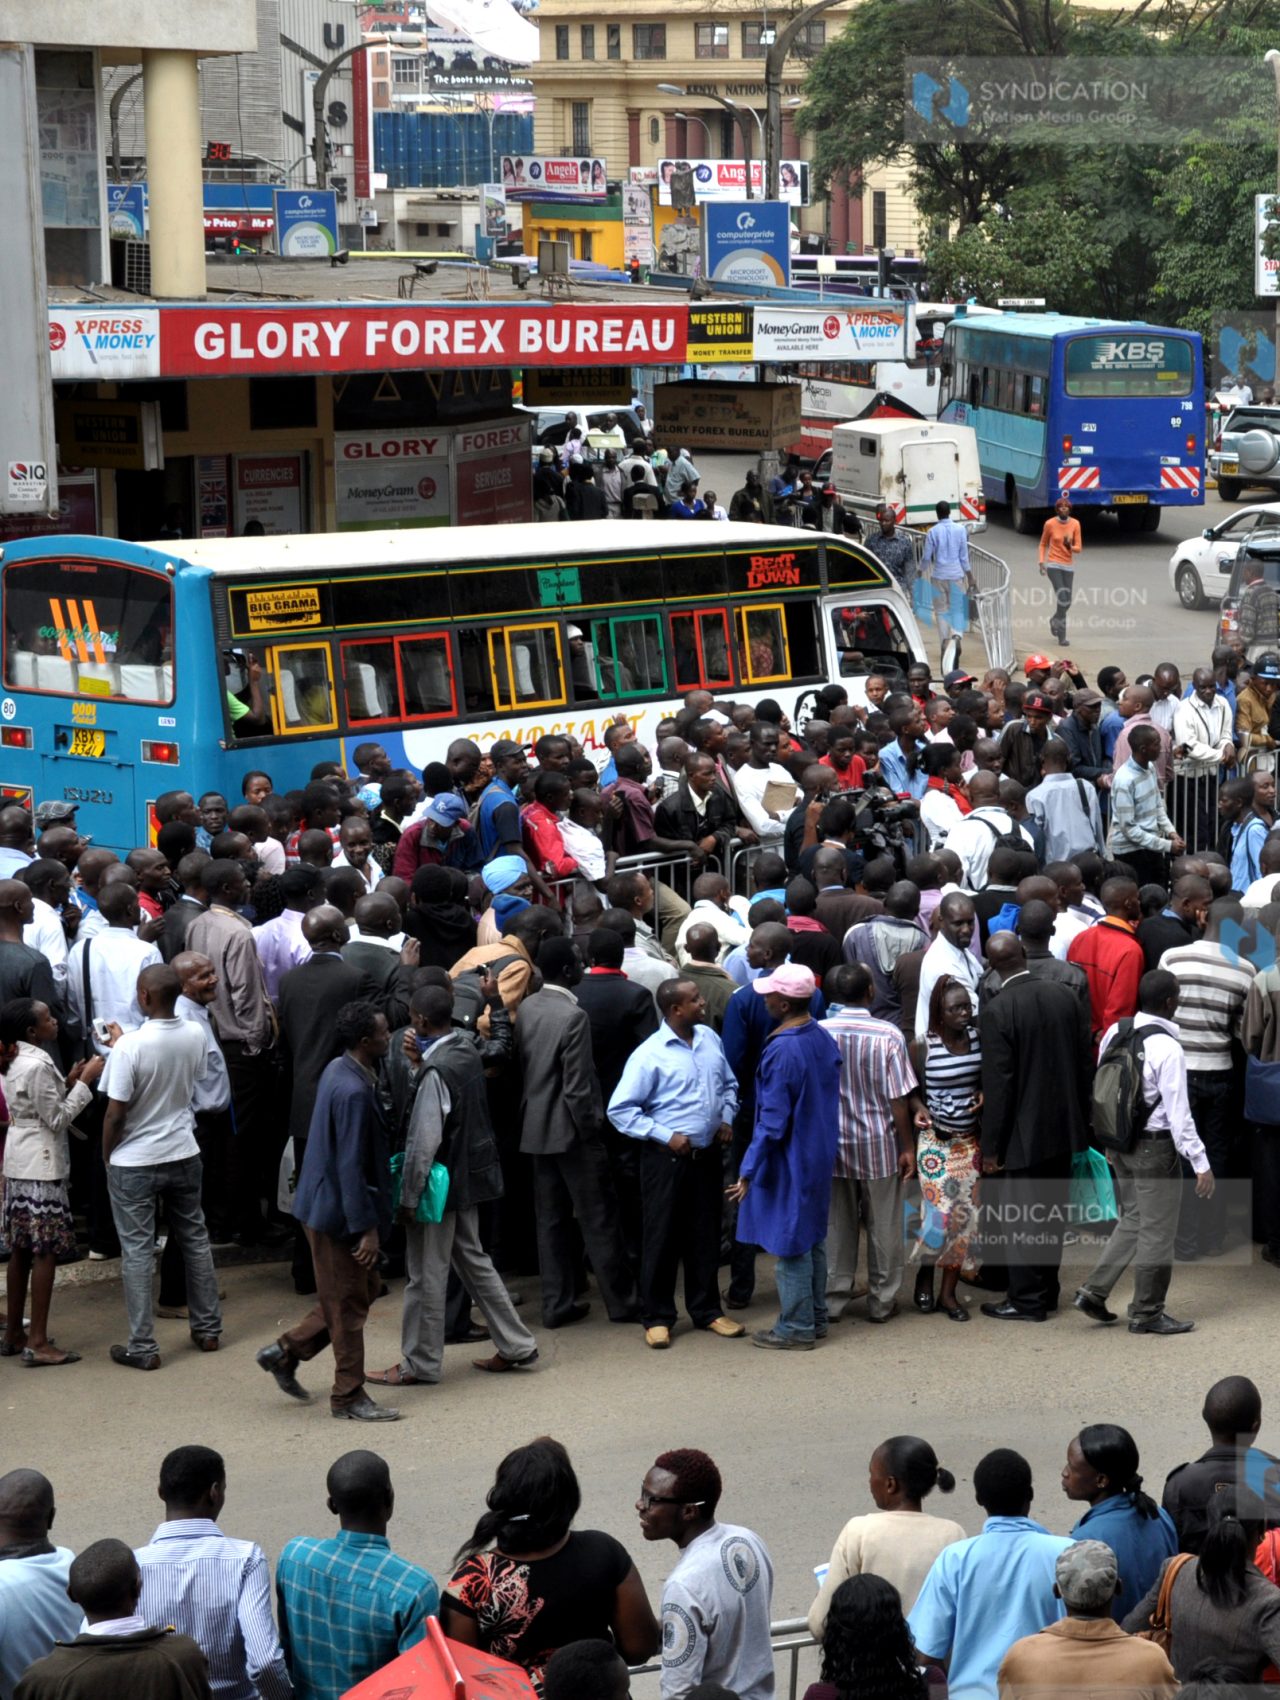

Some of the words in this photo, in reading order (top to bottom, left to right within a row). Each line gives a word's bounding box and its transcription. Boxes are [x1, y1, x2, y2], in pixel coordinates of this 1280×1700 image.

[434, 75, 449, 85] The
[451, 75, 473, 85] boots
[475, 75, 492, 85] that
[494, 77, 508, 87] say
[510, 77, 526, 87] you
[687, 84, 718, 96] KENYA
[725, 84, 768, 96] NATIONA
[210, 143, 231, 160] 30
[547, 163, 577, 178] Angels
[720, 166, 760, 182] Angls
[213, 218, 237, 229] Price
[252, 218, 265, 228] Mr
[717, 230, 775, 240] computerpride
[691, 313, 742, 324] WESTERN
[845, 313, 891, 325] XPRESS
[74, 319, 142, 334] XPRESS
[706, 324, 742, 335] UNION
[757, 321, 820, 337] MoneyGram
[859, 325, 900, 338] MONEY
[95, 334, 155, 349] MONEY
[194, 321, 350, 359] GLORY
[366, 319, 505, 356] FOREX
[519, 319, 675, 353] BUREAU
[1109, 342, 1165, 360] KBS
[562, 376, 611, 386] UNION
[1171, 417, 1182, 425] 80
[656, 424, 690, 435] GLORY
[692, 425, 725, 436] FOREX
[728, 426, 769, 438] BUREAU
[462, 428, 522, 452] FOREX
[343, 438, 438, 459] GLORY
[29, 465, 45, 480] IQ
[244, 467, 294, 482] CURRENCIES
[474, 467, 511, 489] SERVICES
[347, 484, 414, 500] MoneyGram
[250, 603, 271, 613] BIG
[274, 599, 317, 610] GRAMA
[37, 624, 119, 647] compliant
[4, 704, 14, 714] 80
[75, 729, 95, 743] KBX
[70, 743, 96, 757] 334L
[64, 787, 112, 803] ISUZU
